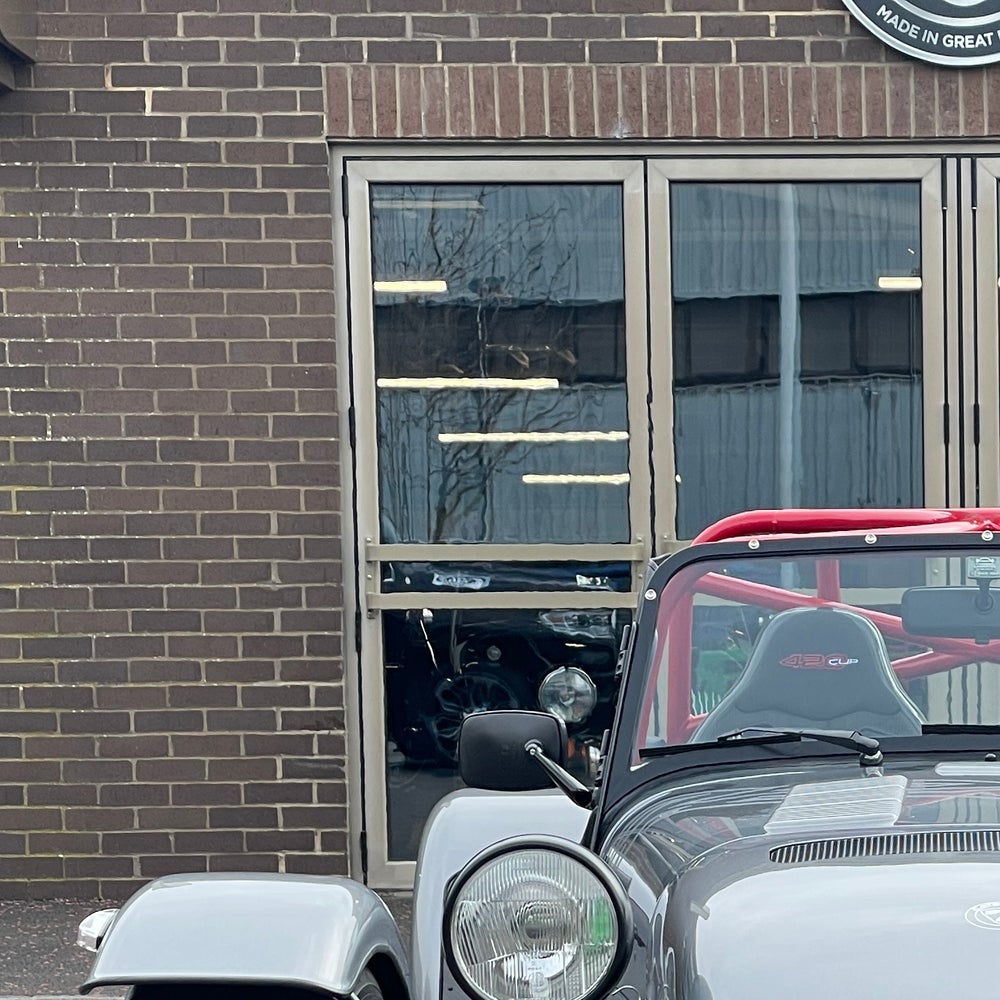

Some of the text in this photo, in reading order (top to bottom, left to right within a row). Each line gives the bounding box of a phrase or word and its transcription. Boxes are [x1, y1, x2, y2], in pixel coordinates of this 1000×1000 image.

[876, 4, 920, 39] MADE
[922, 29, 939, 45] IN
[942, 32, 994, 48] GREAT
[828, 658, 859, 666] CUP
